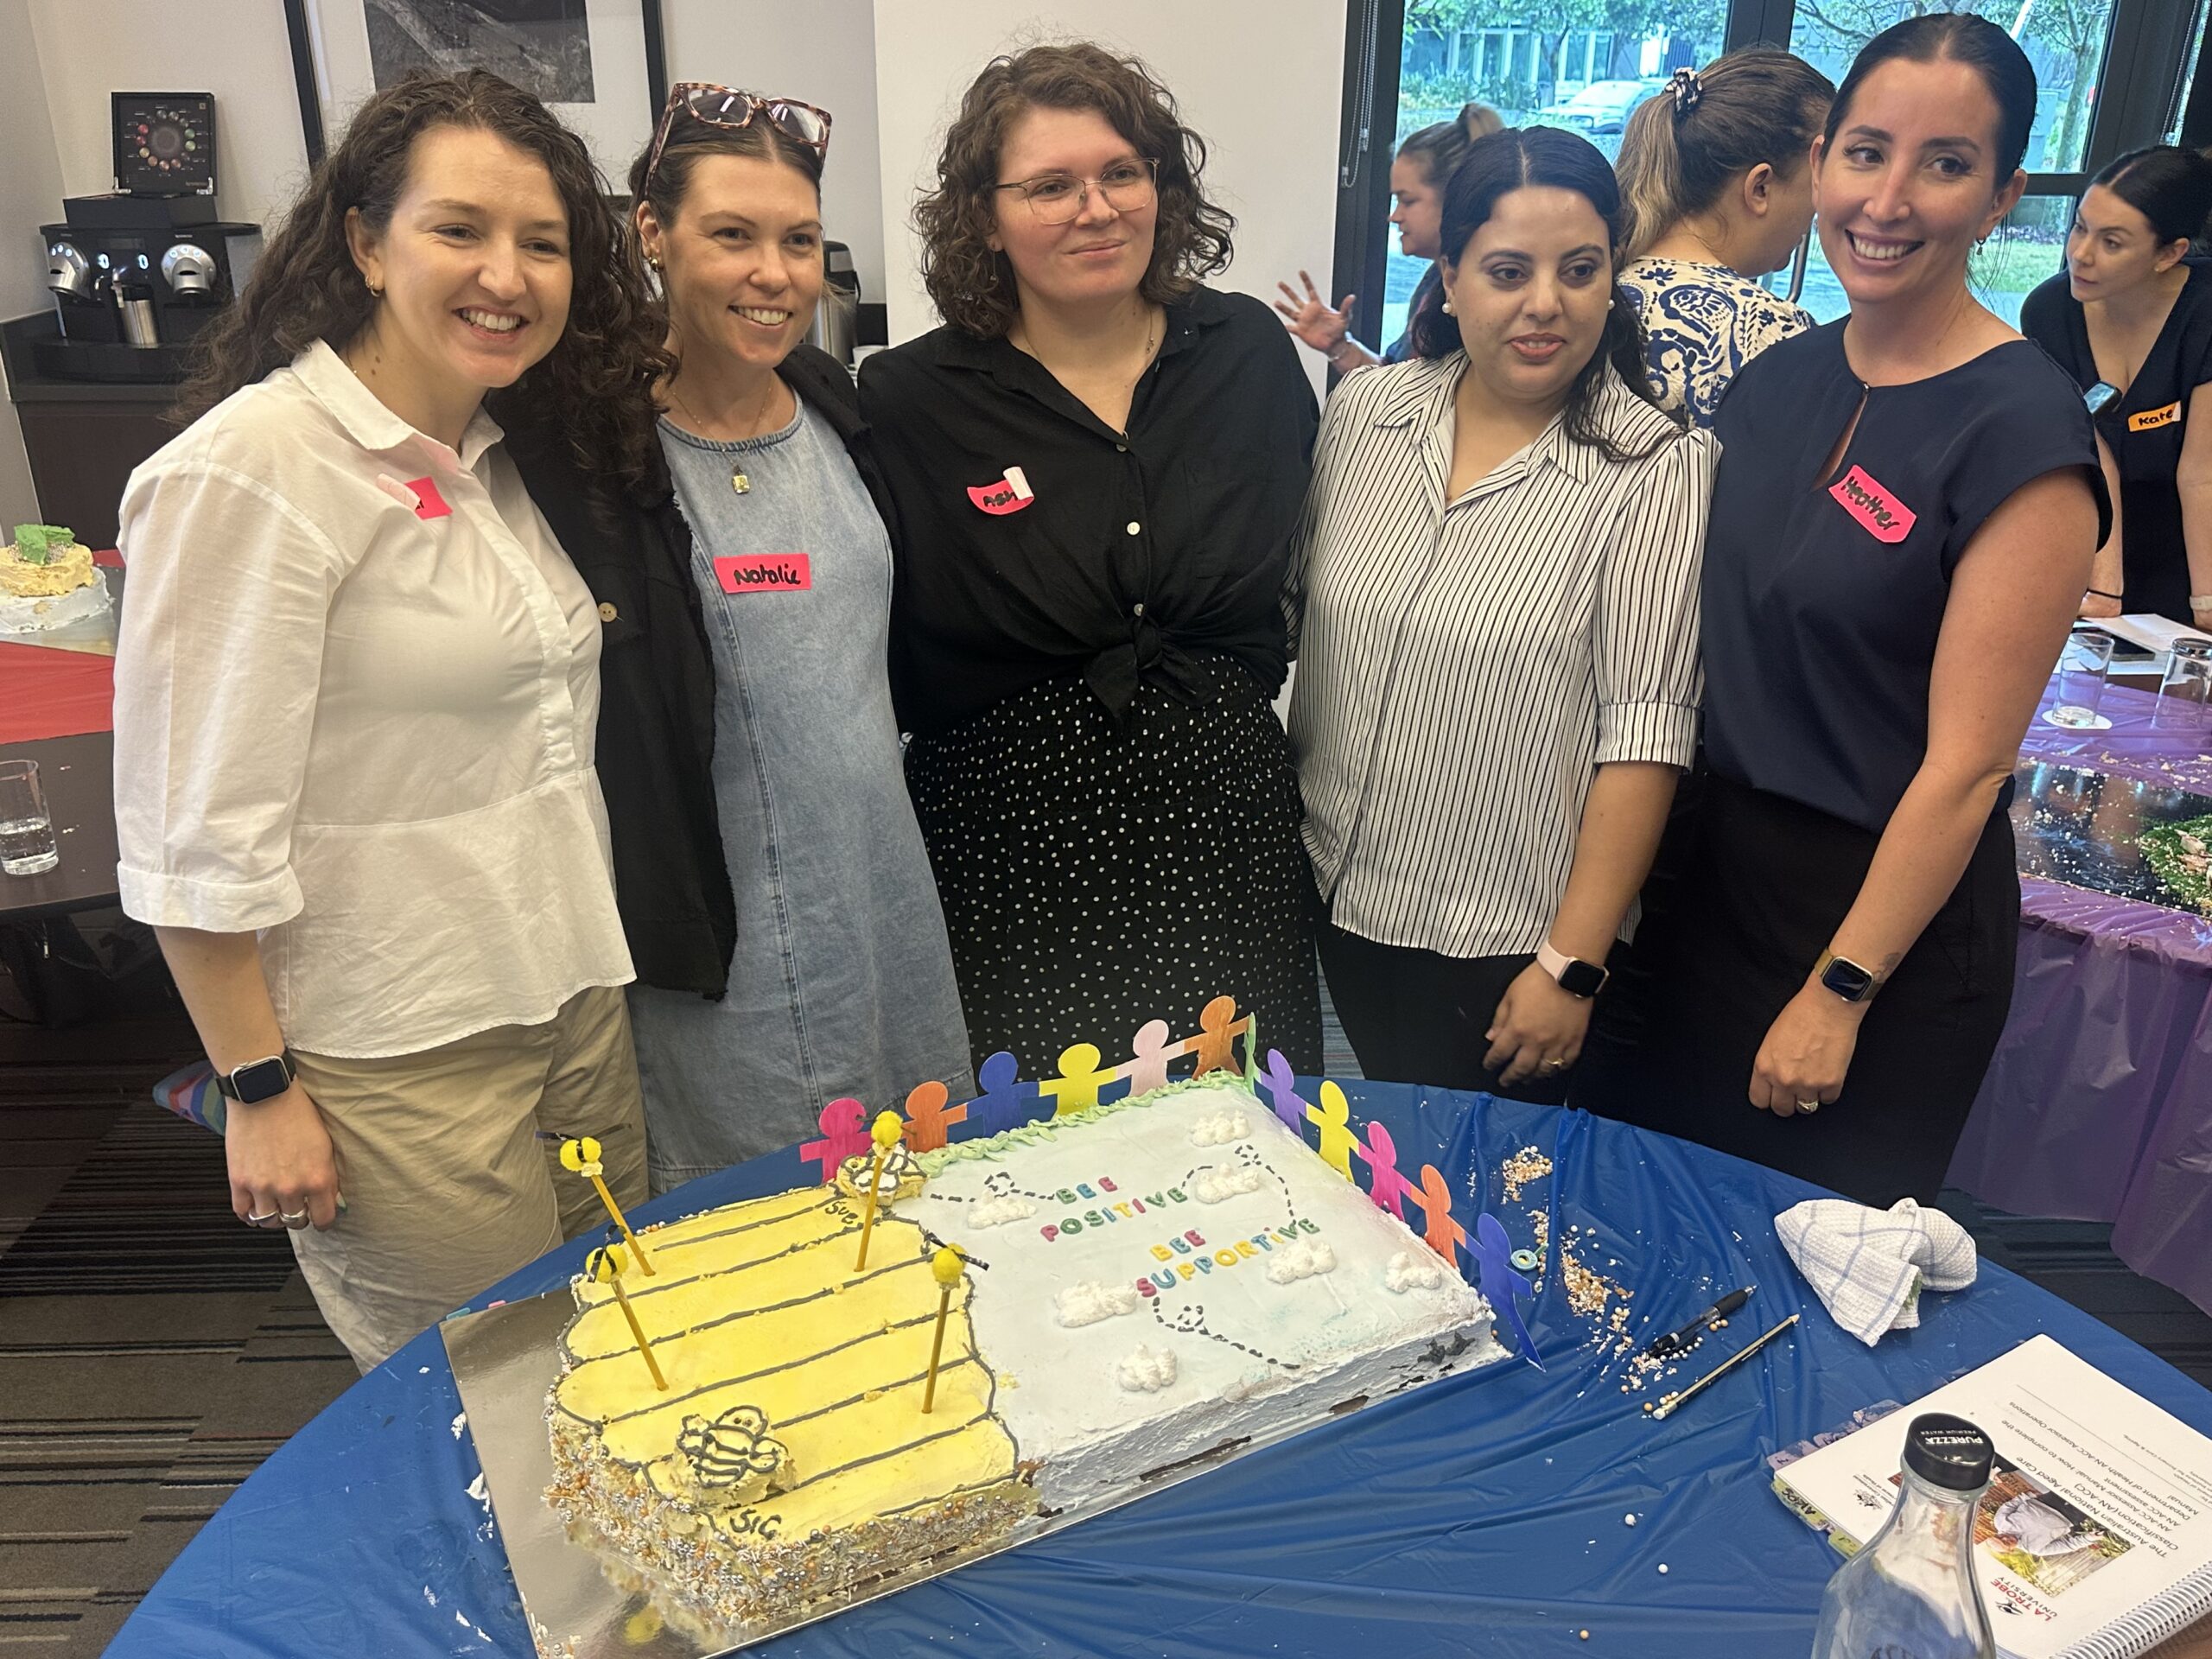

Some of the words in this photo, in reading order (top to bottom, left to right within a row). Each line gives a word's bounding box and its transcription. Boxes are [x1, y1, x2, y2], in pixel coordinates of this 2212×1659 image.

[2138, 409, 2173, 426] Kate
[1840, 475, 1900, 531] Heather
[733, 563, 802, 586] Natalie
[1055, 1175, 1119, 1205] BEE
[1039, 1186, 1188, 1243] POSITIVE
[1149, 1228, 1206, 1262] BEE
[2009, 1402, 2048, 1428] Operations
[1923, 1435, 1985, 1446] PUREZZA
[2046, 1427, 2079, 1448] Assessor
[2016, 1457, 2037, 1472] Care
[2076, 1447, 2108, 1468] AN-ACC
[2036, 1471, 2062, 1488] Aged
[2107, 1466, 2133, 1485] Health
[2059, 1487, 2101, 1516] National
[2074, 1483, 2120, 1513] (AN-ACC)
[2103, 1477, 2149, 1507] assessment
[2142, 1489, 2191, 1521] Department
[2166, 1494, 2199, 1516] Manual
[2100, 1513, 2149, 1545] Australian
[2146, 1506, 2181, 1527] AN-ACC
[2117, 1511, 2179, 1551] Classification
[2148, 1544, 2168, 1558] The
[1990, 1579, 2033, 1610] TROBE
[1995, 1576, 2058, 1618] UNIVERSITY
[2034, 1608, 2052, 1622] LA
